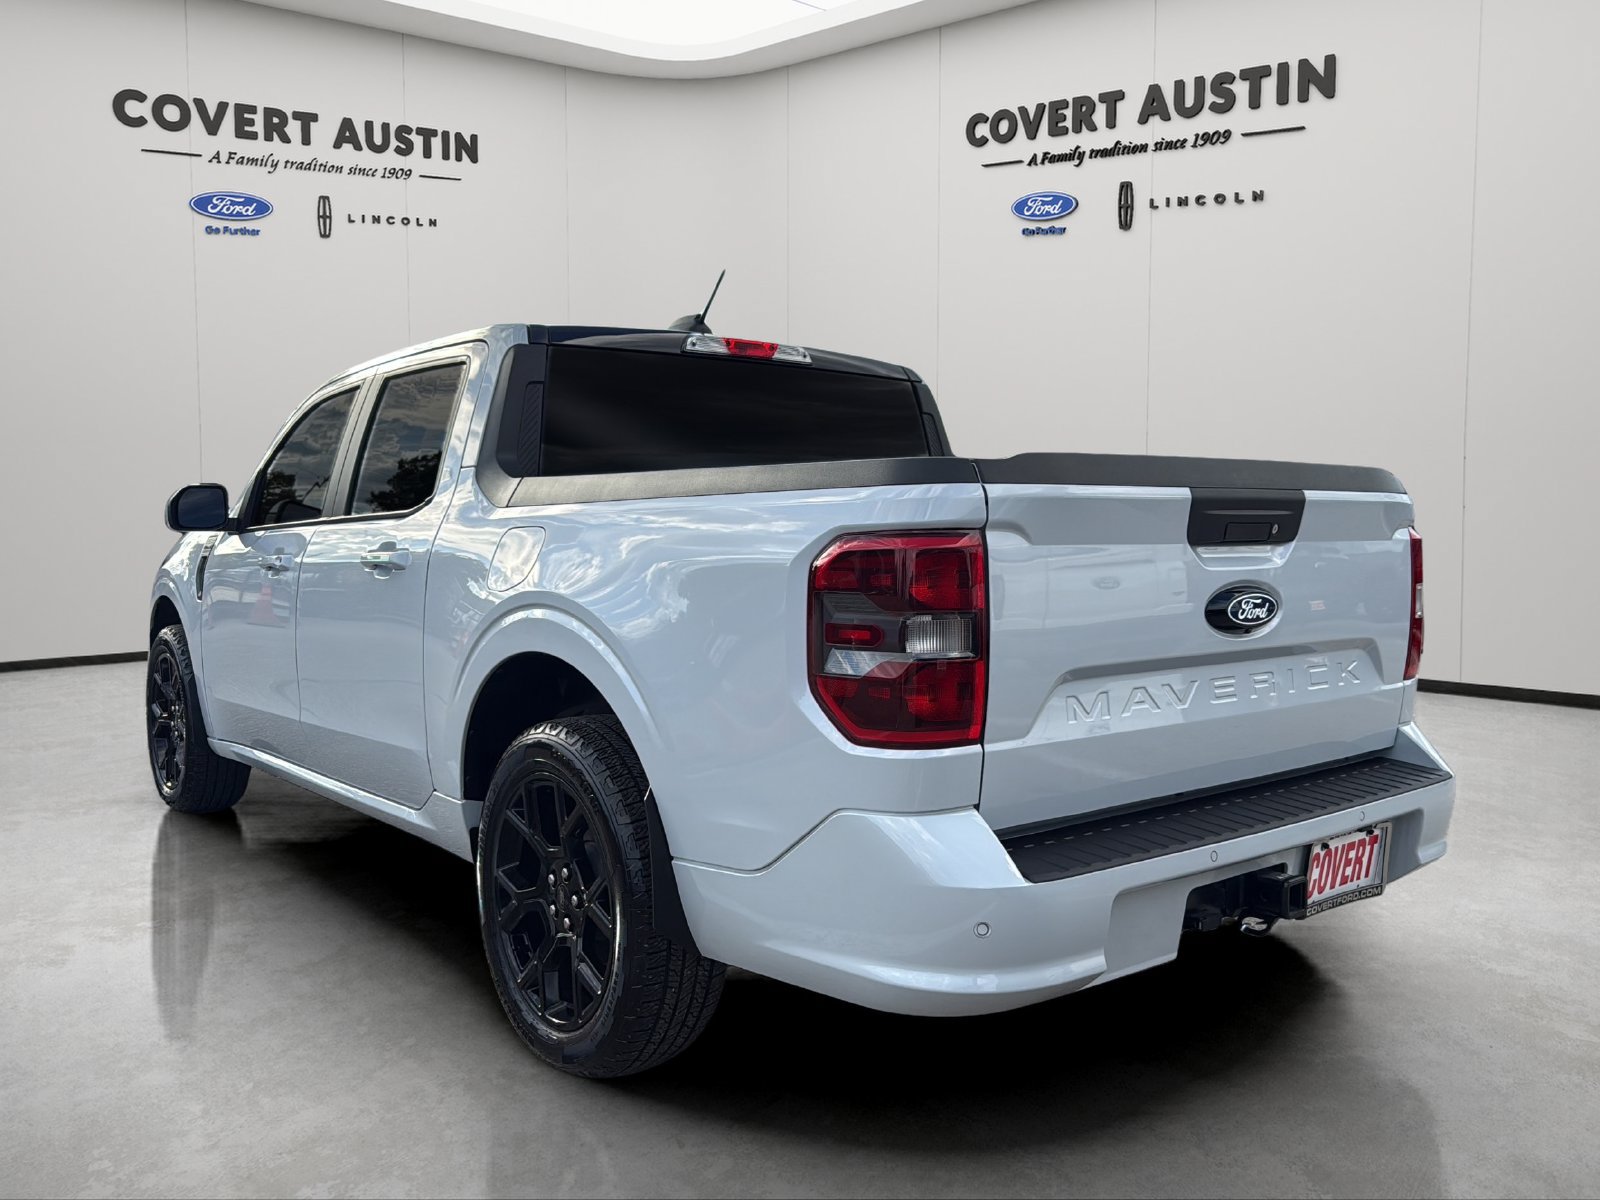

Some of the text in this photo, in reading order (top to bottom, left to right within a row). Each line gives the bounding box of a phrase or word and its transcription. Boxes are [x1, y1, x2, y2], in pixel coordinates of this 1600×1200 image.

[965, 53, 1337, 148] COVERT AUSTIN
[112, 88, 479, 164] COVERT AUSTIN
[1026, 128, 1232, 168] A Family tradition since 1909
[208, 150, 413, 180] A Family tradition since 1909
[207, 195, 257, 216] Ford
[1023, 196, 1063, 216] Ford
[1149, 189, 1265, 210] LINCOLN
[204, 225, 261, 237] Go Further
[347, 213, 438, 228] LINCOLN
[1237, 598, 1269, 620] Ford
[1065, 659, 1361, 724] MAVERICK
[1306, 834, 1379, 900] COVERT
[1306, 886, 1381, 916] COVERTFORD.COM
